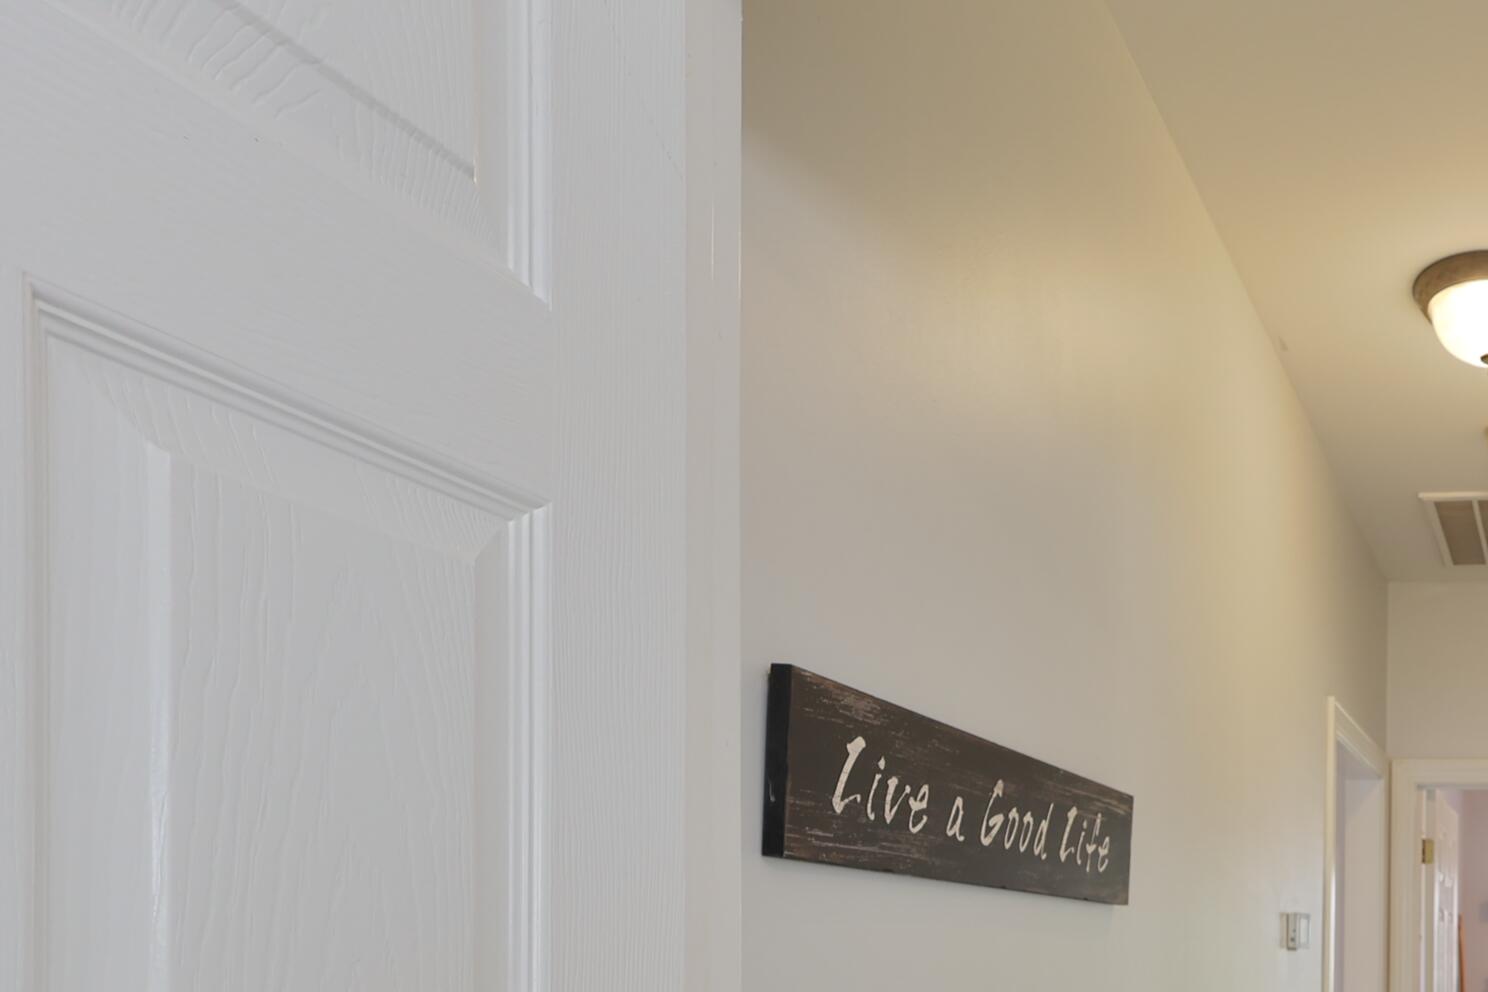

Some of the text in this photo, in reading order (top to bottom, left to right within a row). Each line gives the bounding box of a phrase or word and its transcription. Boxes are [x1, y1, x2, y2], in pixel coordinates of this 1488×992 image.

[831, 735, 1111, 874] Live a Good Life
